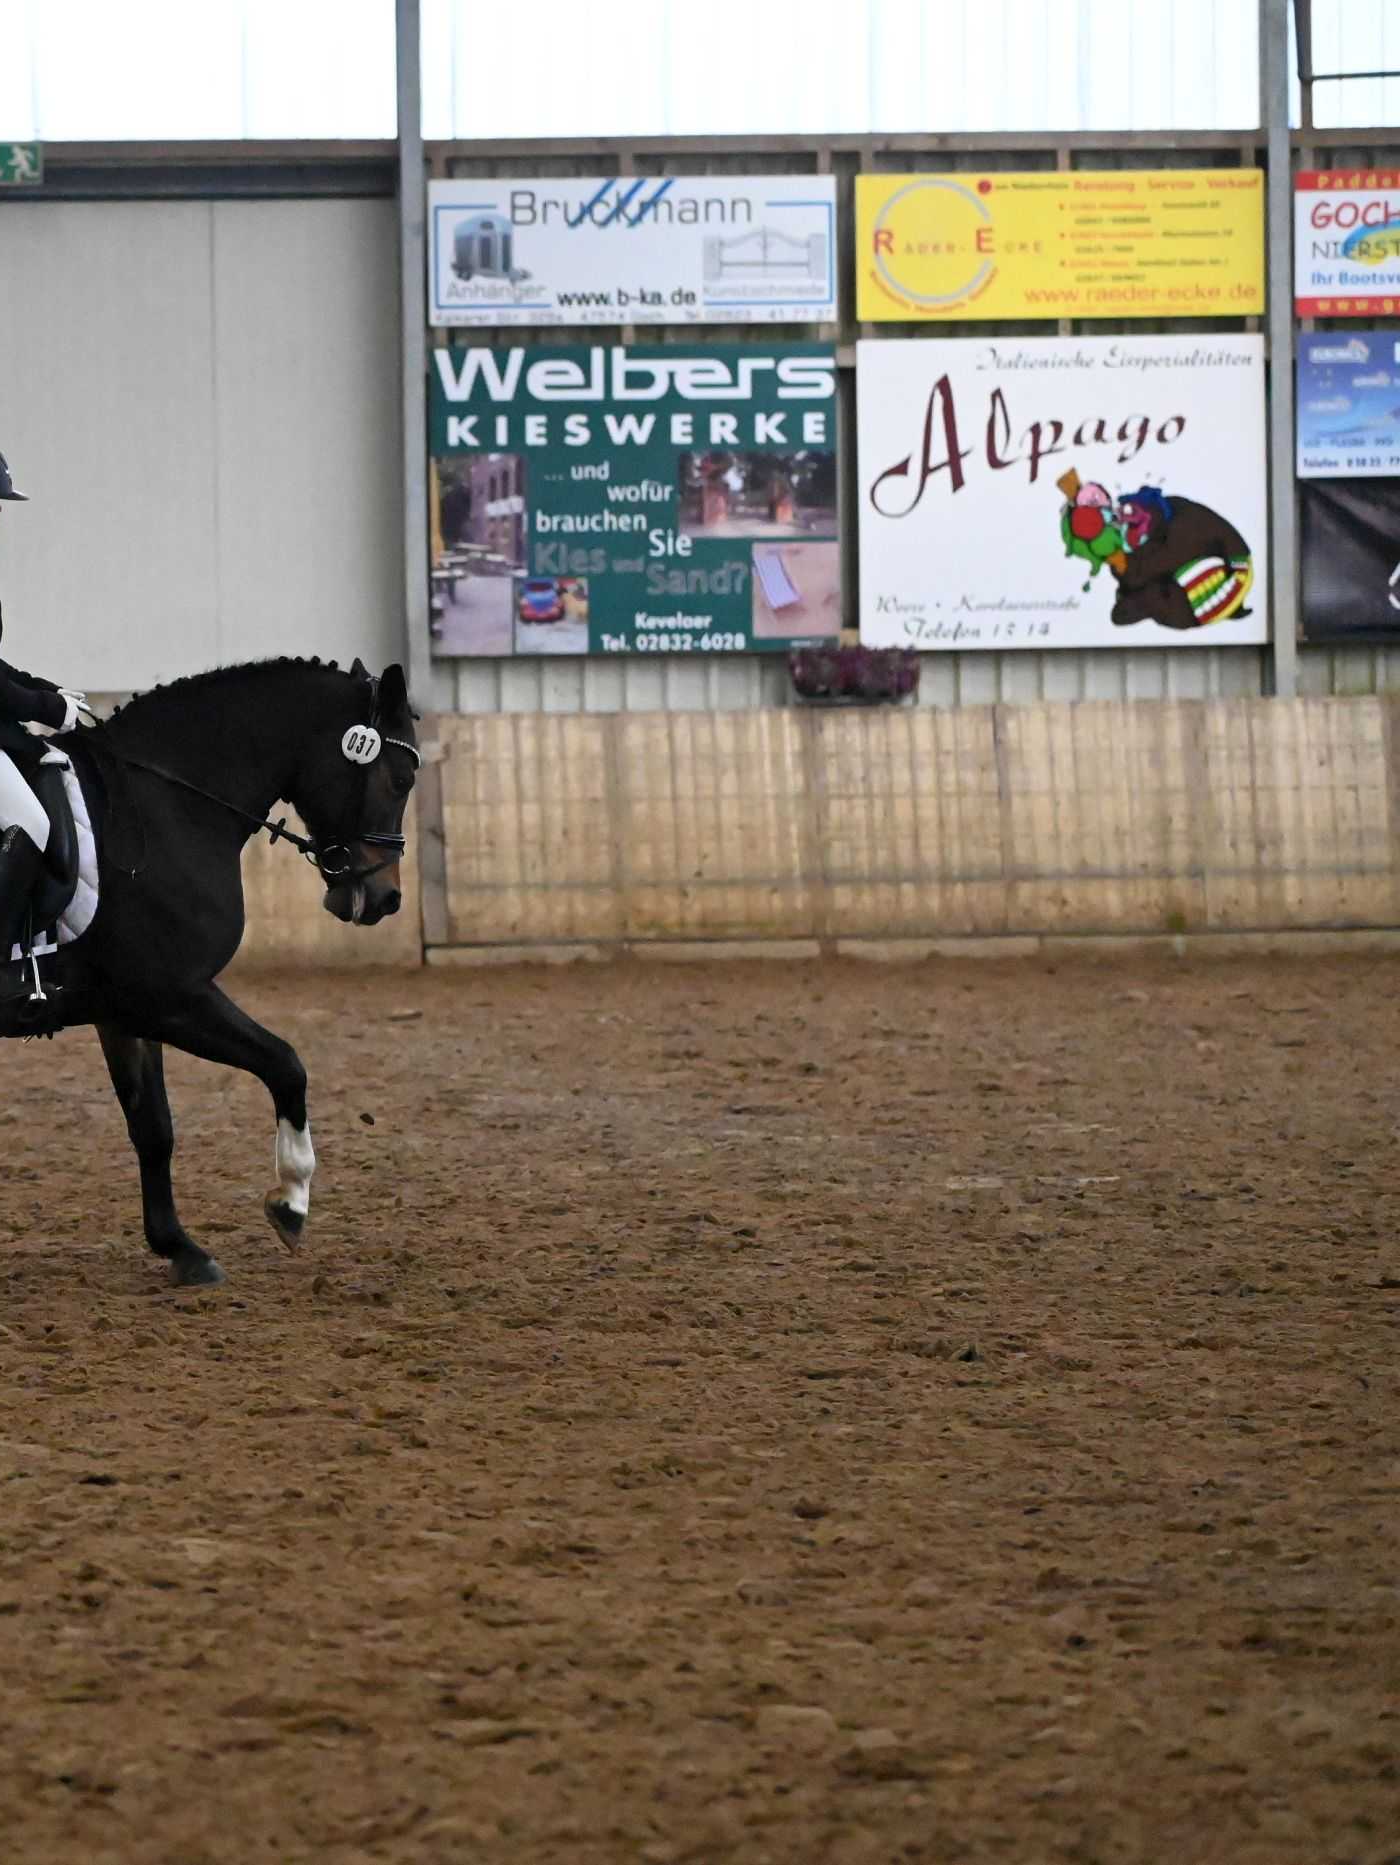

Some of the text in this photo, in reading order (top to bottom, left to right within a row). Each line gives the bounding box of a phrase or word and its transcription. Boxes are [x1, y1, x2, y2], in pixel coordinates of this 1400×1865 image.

[1317, 173, 1400, 190] Padde
[1311, 269, 1400, 285] Ihr Bootsv
[434, 346, 836, 401] Welbers
[447, 412, 827, 447] KIESWERKE
[870, 373, 1186, 519] Alpago
[571, 460, 610, 480] und
[607, 480, 674, 502] wofür
[536, 509, 648, 533] brauchen
[649, 528, 692, 557] Sie
[535, 543, 606, 575] Kies
[646, 561, 749, 595] Sand?
[903, 616, 981, 642] Telefon
[601, 633, 631, 651] Tel.
[347, 732, 376, 757] 037
